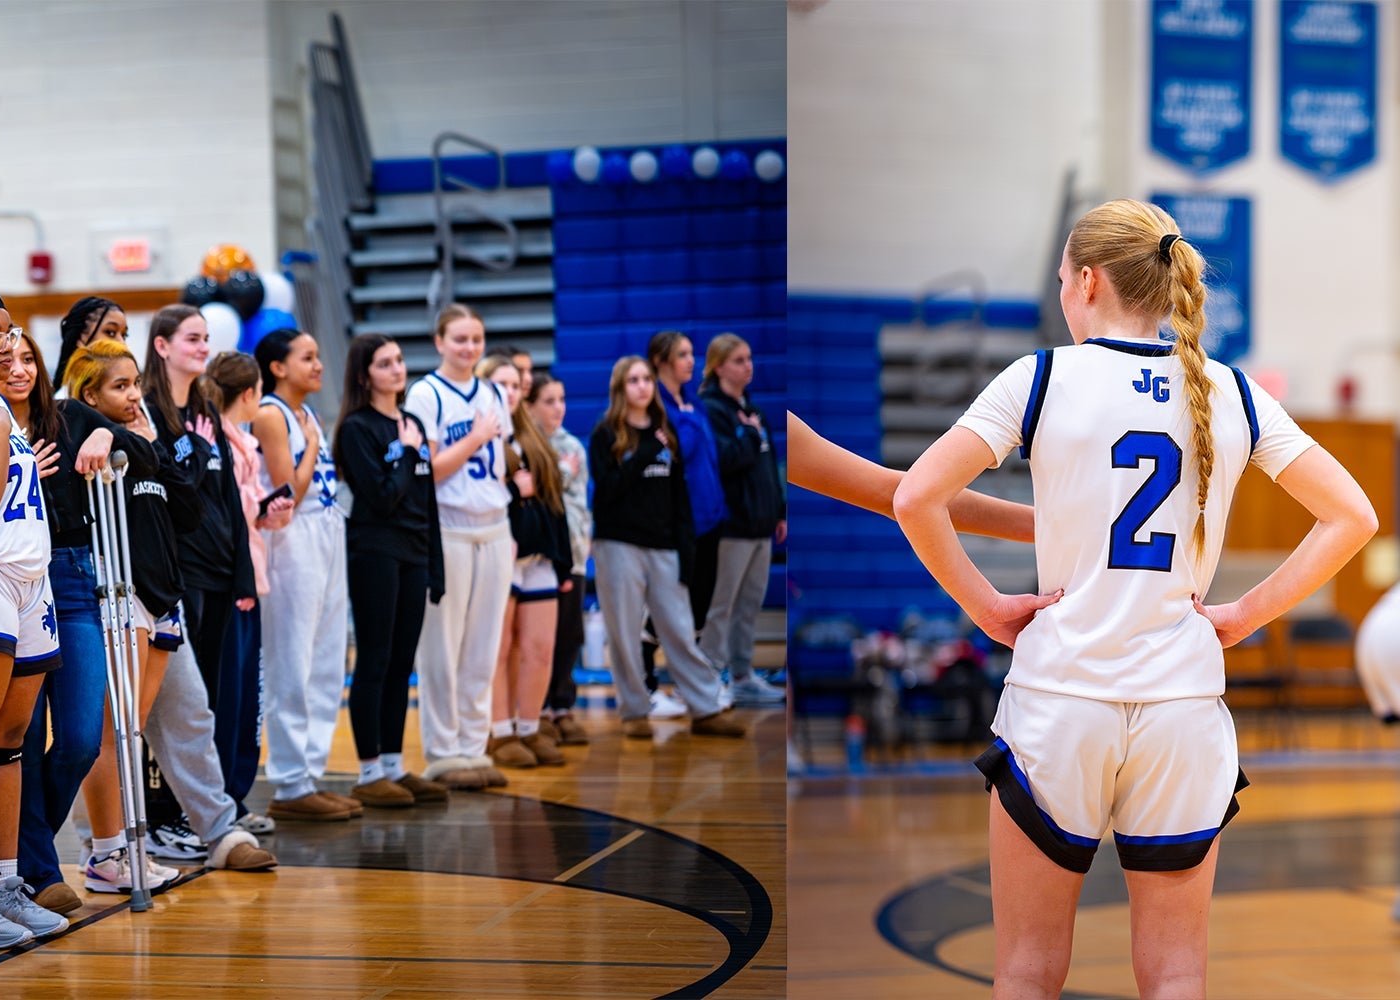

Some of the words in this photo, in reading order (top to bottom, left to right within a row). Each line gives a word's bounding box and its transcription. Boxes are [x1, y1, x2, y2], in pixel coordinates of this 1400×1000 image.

[1132, 369, 1170, 403] JG
[3, 461, 44, 523] 24
[1107, 430, 1183, 573] 2
